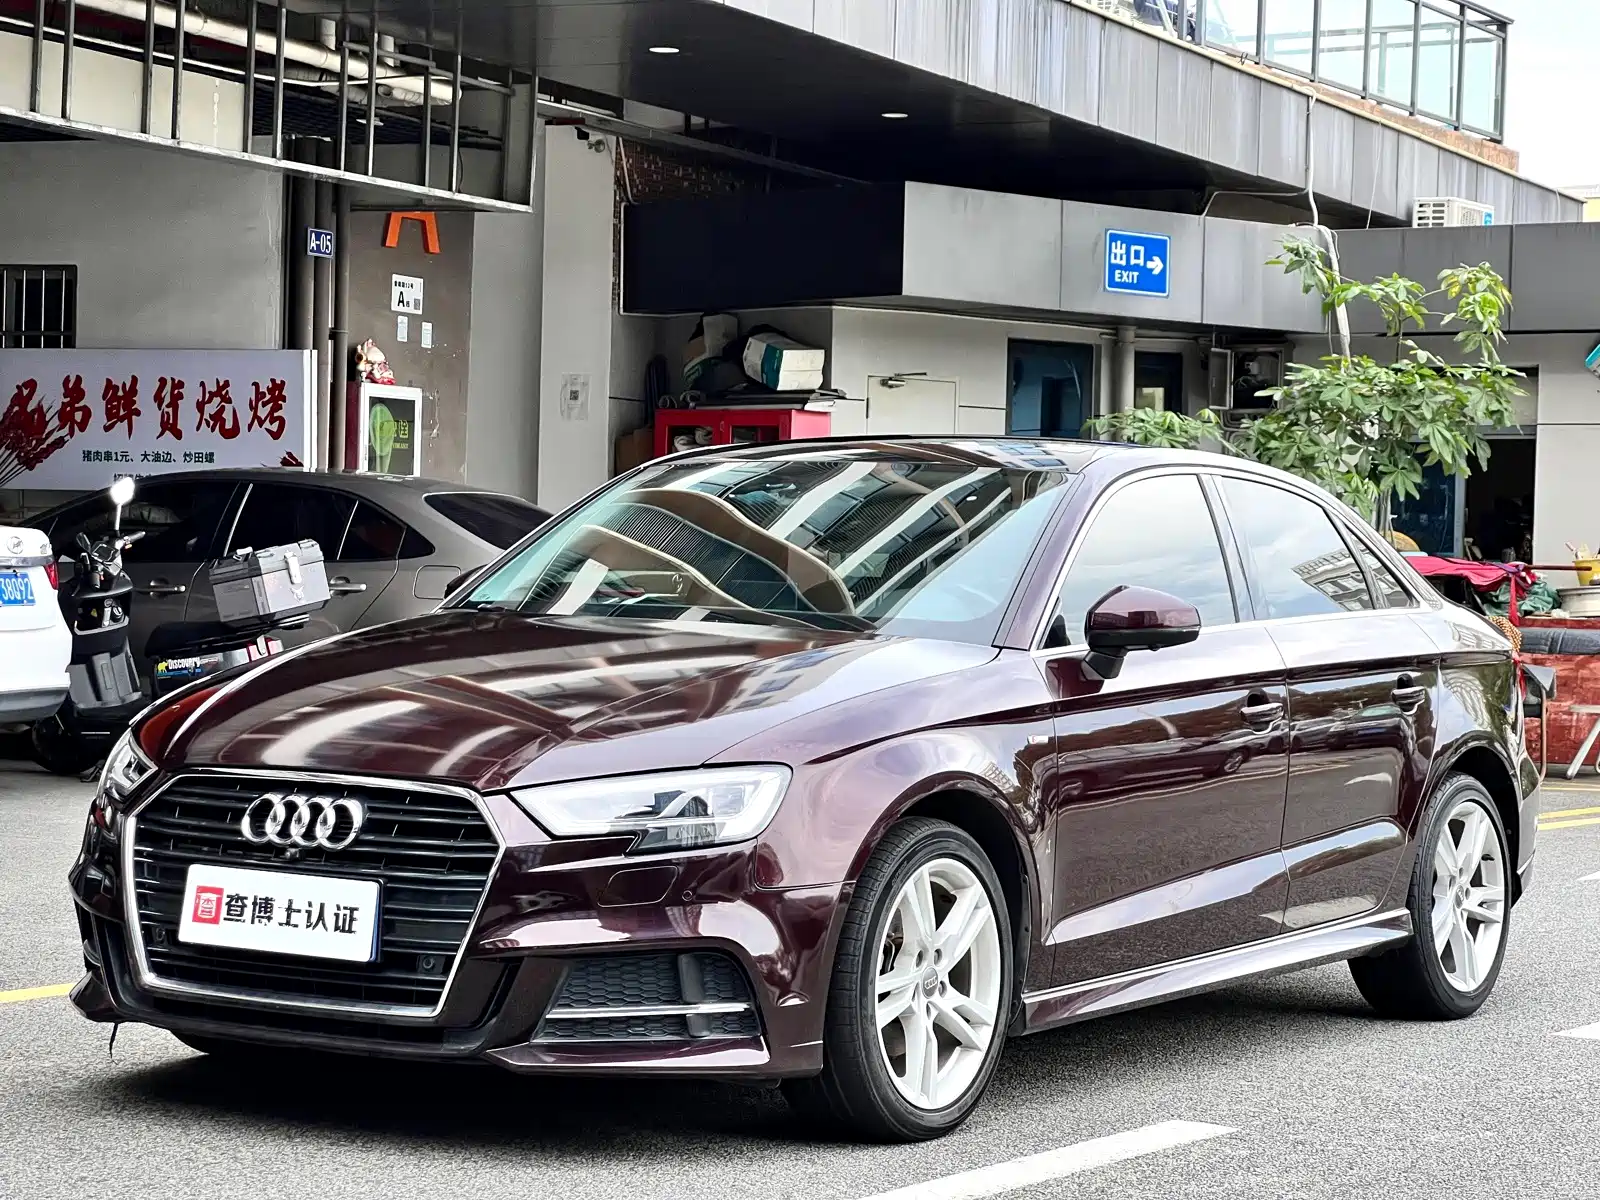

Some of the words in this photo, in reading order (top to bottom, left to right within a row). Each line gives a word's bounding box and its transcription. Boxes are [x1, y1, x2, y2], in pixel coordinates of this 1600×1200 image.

[309, 232, 332, 254] A-05
[1110, 240, 1145, 266] 出口
[1114, 269, 1140, 284] EXIT
[82, 449, 215, 464] 猪肉串1元、大油边、炒田螺
[223, 892, 360, 935] 查博士认证
